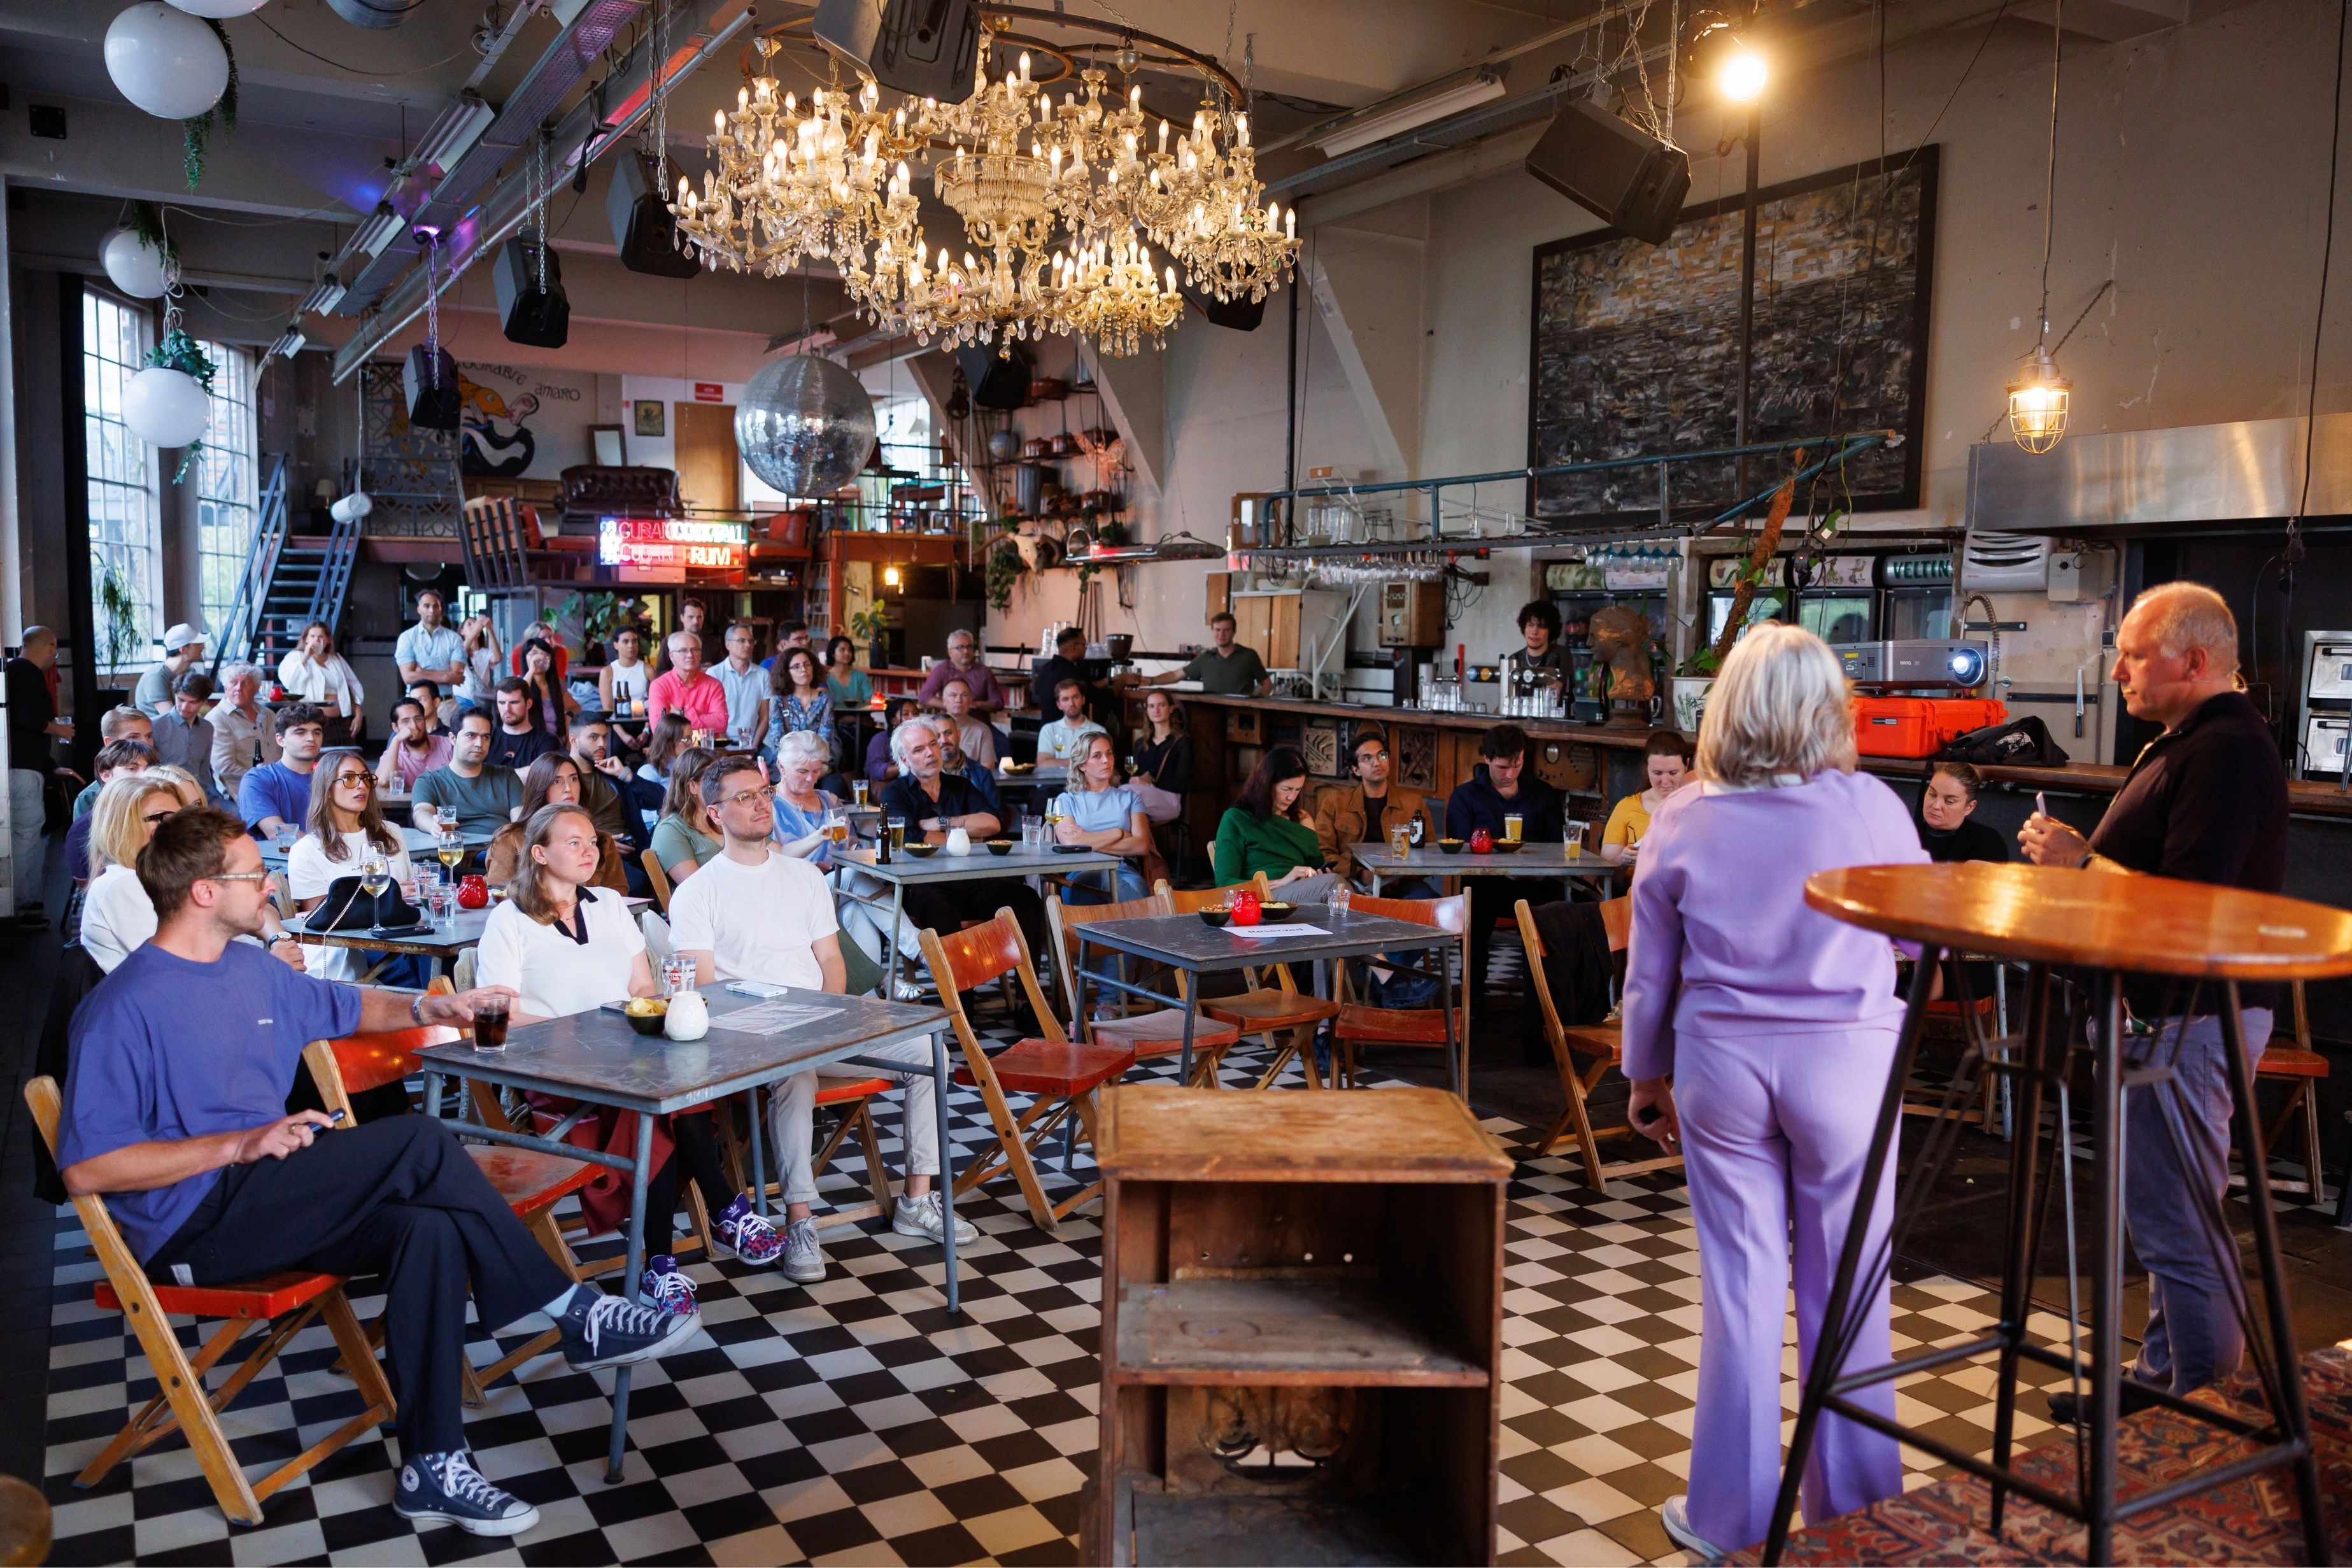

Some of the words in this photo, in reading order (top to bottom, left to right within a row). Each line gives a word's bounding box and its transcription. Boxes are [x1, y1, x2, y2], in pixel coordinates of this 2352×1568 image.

[620, 543, 674, 563] CUBAN
[689, 546, 731, 566] RUM
[1893, 560, 1953, 579] VELTIN
